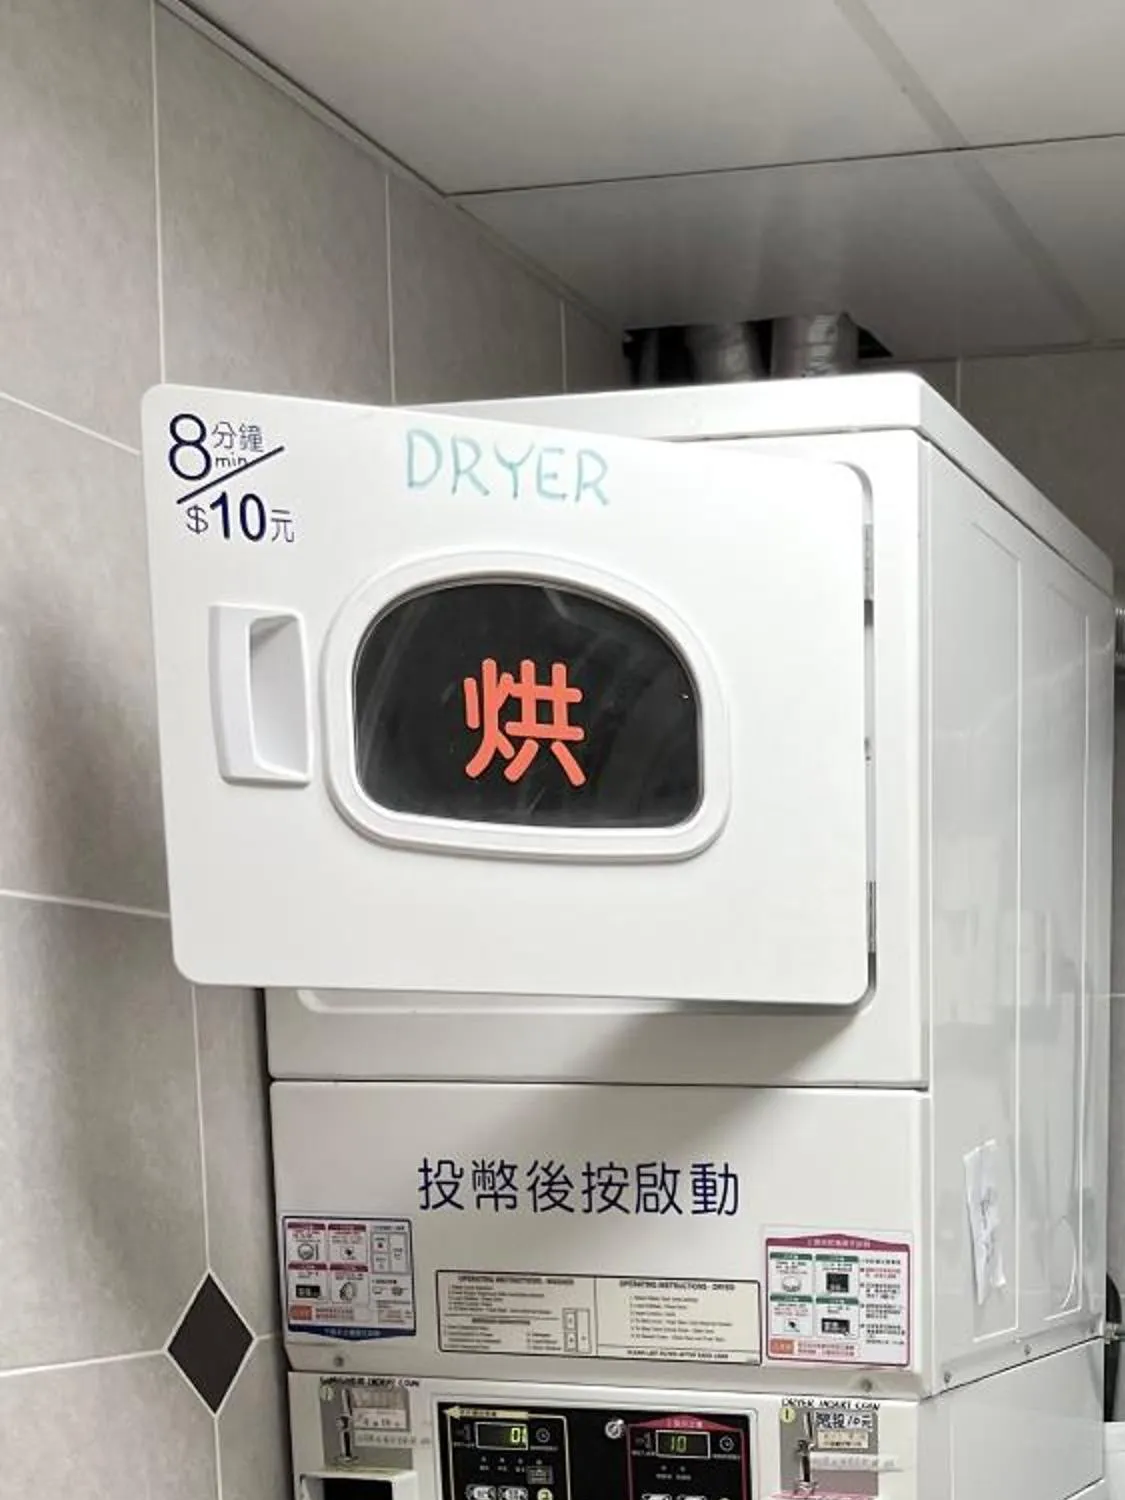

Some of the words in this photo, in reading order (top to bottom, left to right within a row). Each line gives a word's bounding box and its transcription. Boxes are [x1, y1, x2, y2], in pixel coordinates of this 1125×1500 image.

[405, 428, 610, 506] DRYER
[463, 657, 586, 786] 烘
[417, 1158, 740, 1217] 投幣後按啟動
[669, 1435, 687, 1453] 10
